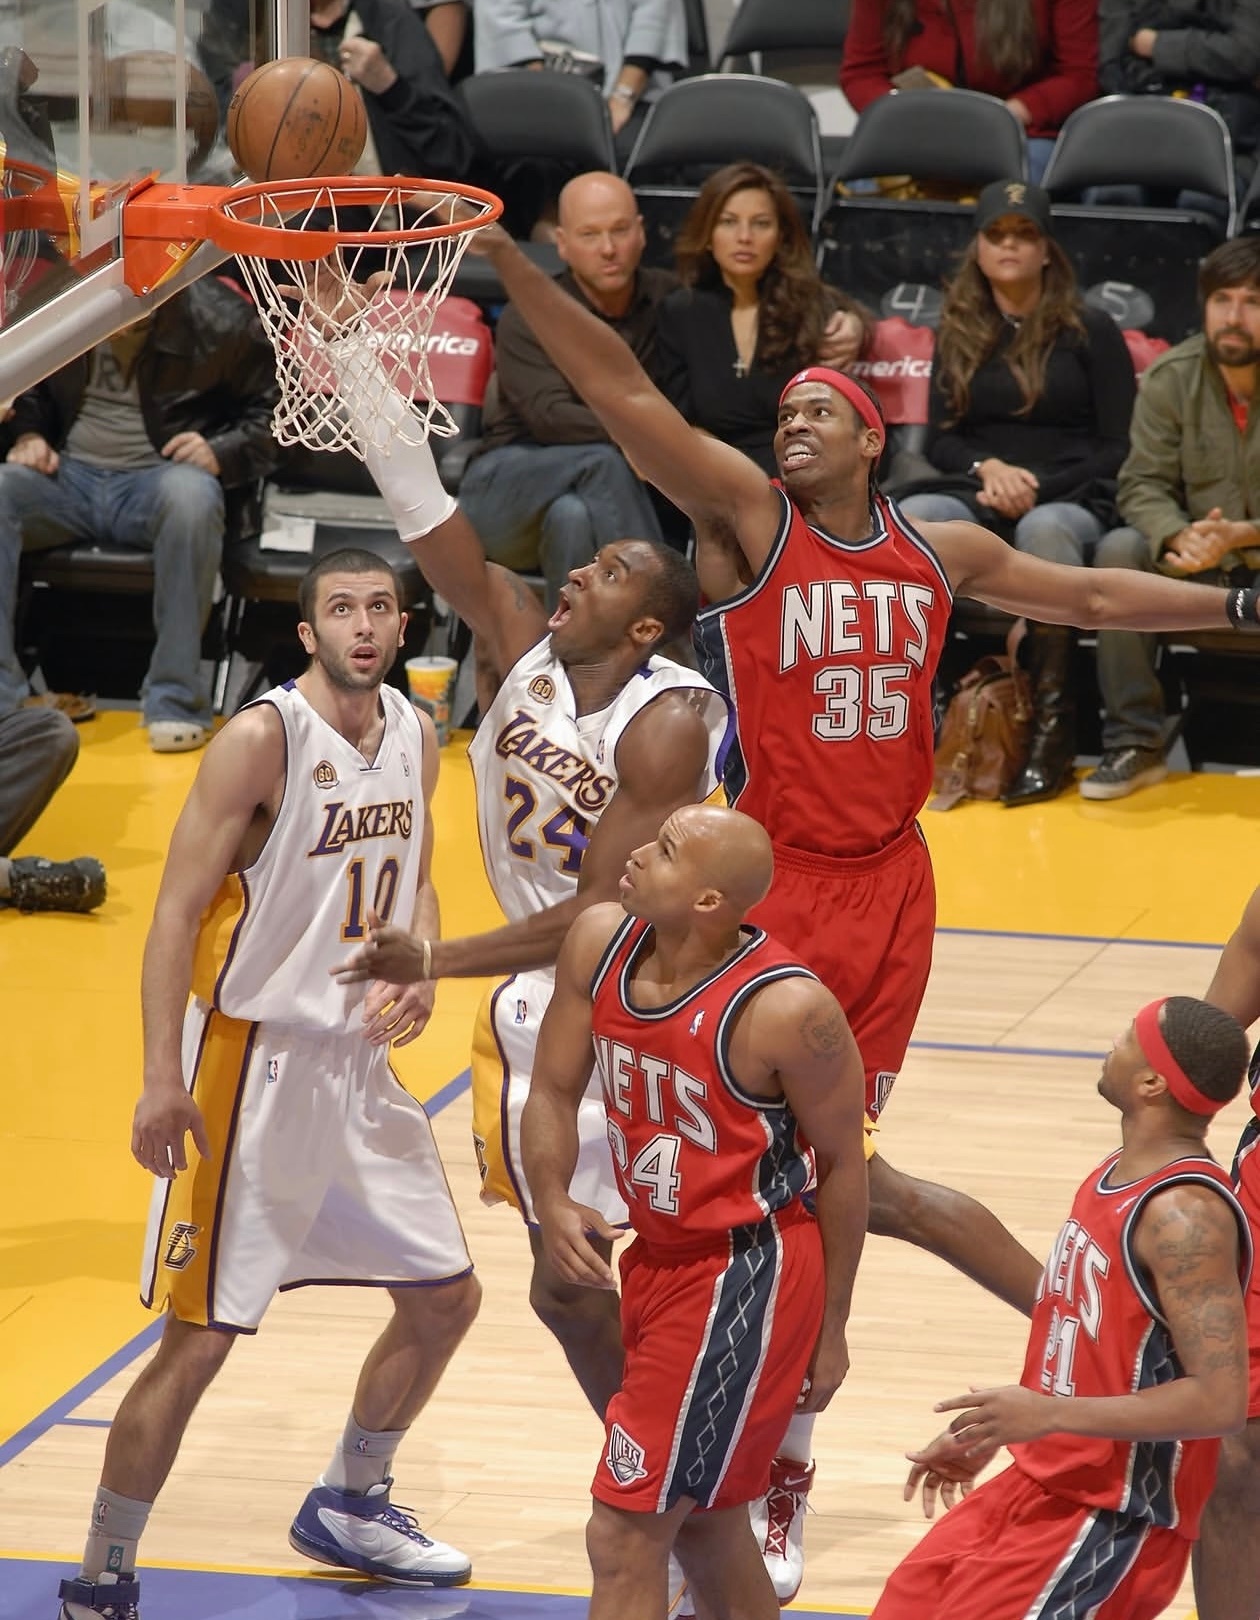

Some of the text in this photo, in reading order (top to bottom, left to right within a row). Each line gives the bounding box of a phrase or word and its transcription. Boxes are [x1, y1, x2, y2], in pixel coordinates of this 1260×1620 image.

[890, 283, 927, 322] 4
[1102, 281, 1134, 322] 5
[779, 579, 935, 675] NETS
[811, 661, 913, 742] 35
[494, 707, 618, 813] LAKERS
[306, 799, 414, 858] LAKERS
[503, 772, 592, 875] 24
[338, 855, 400, 944] 10
[591, 1031, 719, 1156] NETS
[613, 1430, 641, 1469] NETS
